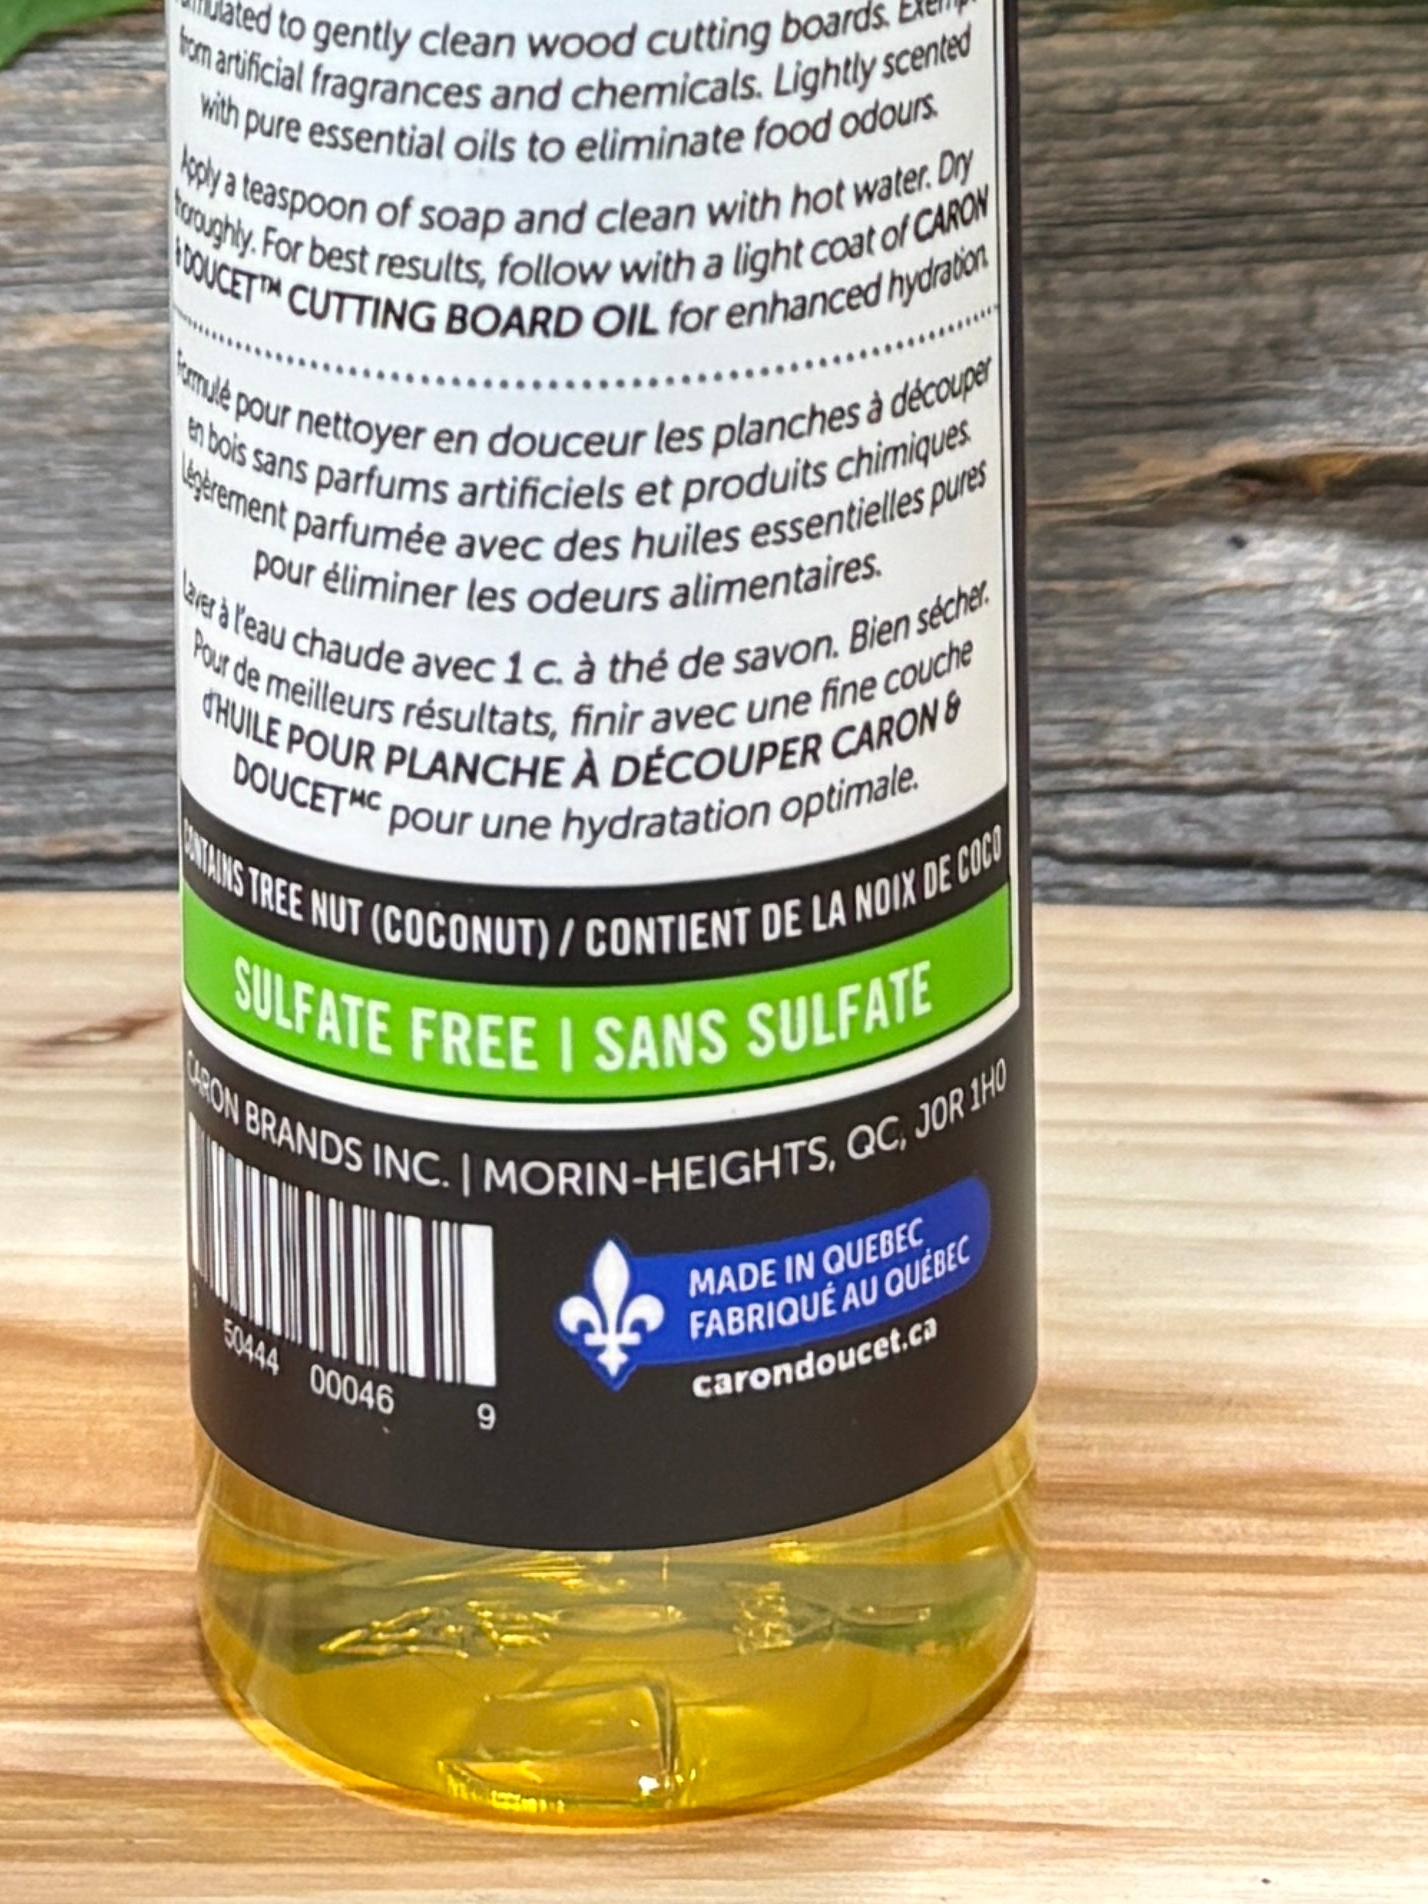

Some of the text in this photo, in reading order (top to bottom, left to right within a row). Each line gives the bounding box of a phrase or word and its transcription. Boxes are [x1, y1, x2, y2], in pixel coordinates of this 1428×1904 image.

[214, 21, 972, 112] artificial fragrances and chemicals. Lightly scented
[278, 9, 307, 43] to
[312, 18, 413, 63] gently
[418, 22, 517, 59] clean
[527, 21, 639, 60] wood
[645, 16, 772, 58] cutting
[243, 92, 939, 165] pure essential oils to eliminate food odours.
[242, 148, 975, 242] teaspoon of soap and clean with hot water. Dry
[261, 183, 990, 291] For best results, follow with a light coat of CARON
[287, 270, 884, 340] CUTTING BOARD OIL for enhanced
[234, 355, 993, 459] pour nettoyer en douceur les planches à découper
[207, 418, 972, 514] bois sans parfums artificiels et produits chimiques.
[292, 458, 987, 563] parfumée avec des huiles essentielles pures
[252, 548, 883, 615] pour éliminer les odeurs alimentaires.
[291, 579, 990, 687] chaude avec 1 c. à thé de savon. Bien sécher.
[193, 627, 974, 743] Pour meilleurs résultats, finir avec une fine couche
[285, 688, 962, 790] POUR PLANCHE À DÉCOUPER CARON &
[387, 762, 919, 851] pour une hydratation optimale.
[247, 824, 1002, 961] TREE NUT (COCONUT) CONTIENT DE LA NOIX DE COCO
[234, 957, 931, 1072] SULFATE FREE SANS SULFATE
[244, 1099, 364, 1173] BRANDS
[373, 1142, 450, 1188] INC.
[483, 1135, 836, 1197] MORIN-HEIGHTS,
[846, 1115, 907, 1161] QC,
[688, 1216, 924, 1299] MADE IN QUEBEC
[689, 1234, 971, 1341] FABRIQUÉ AU QUÉBEC
[223, 1317, 497, 1431] 50444 00046 9
[691, 1316, 938, 1399] carondoucet.ca
